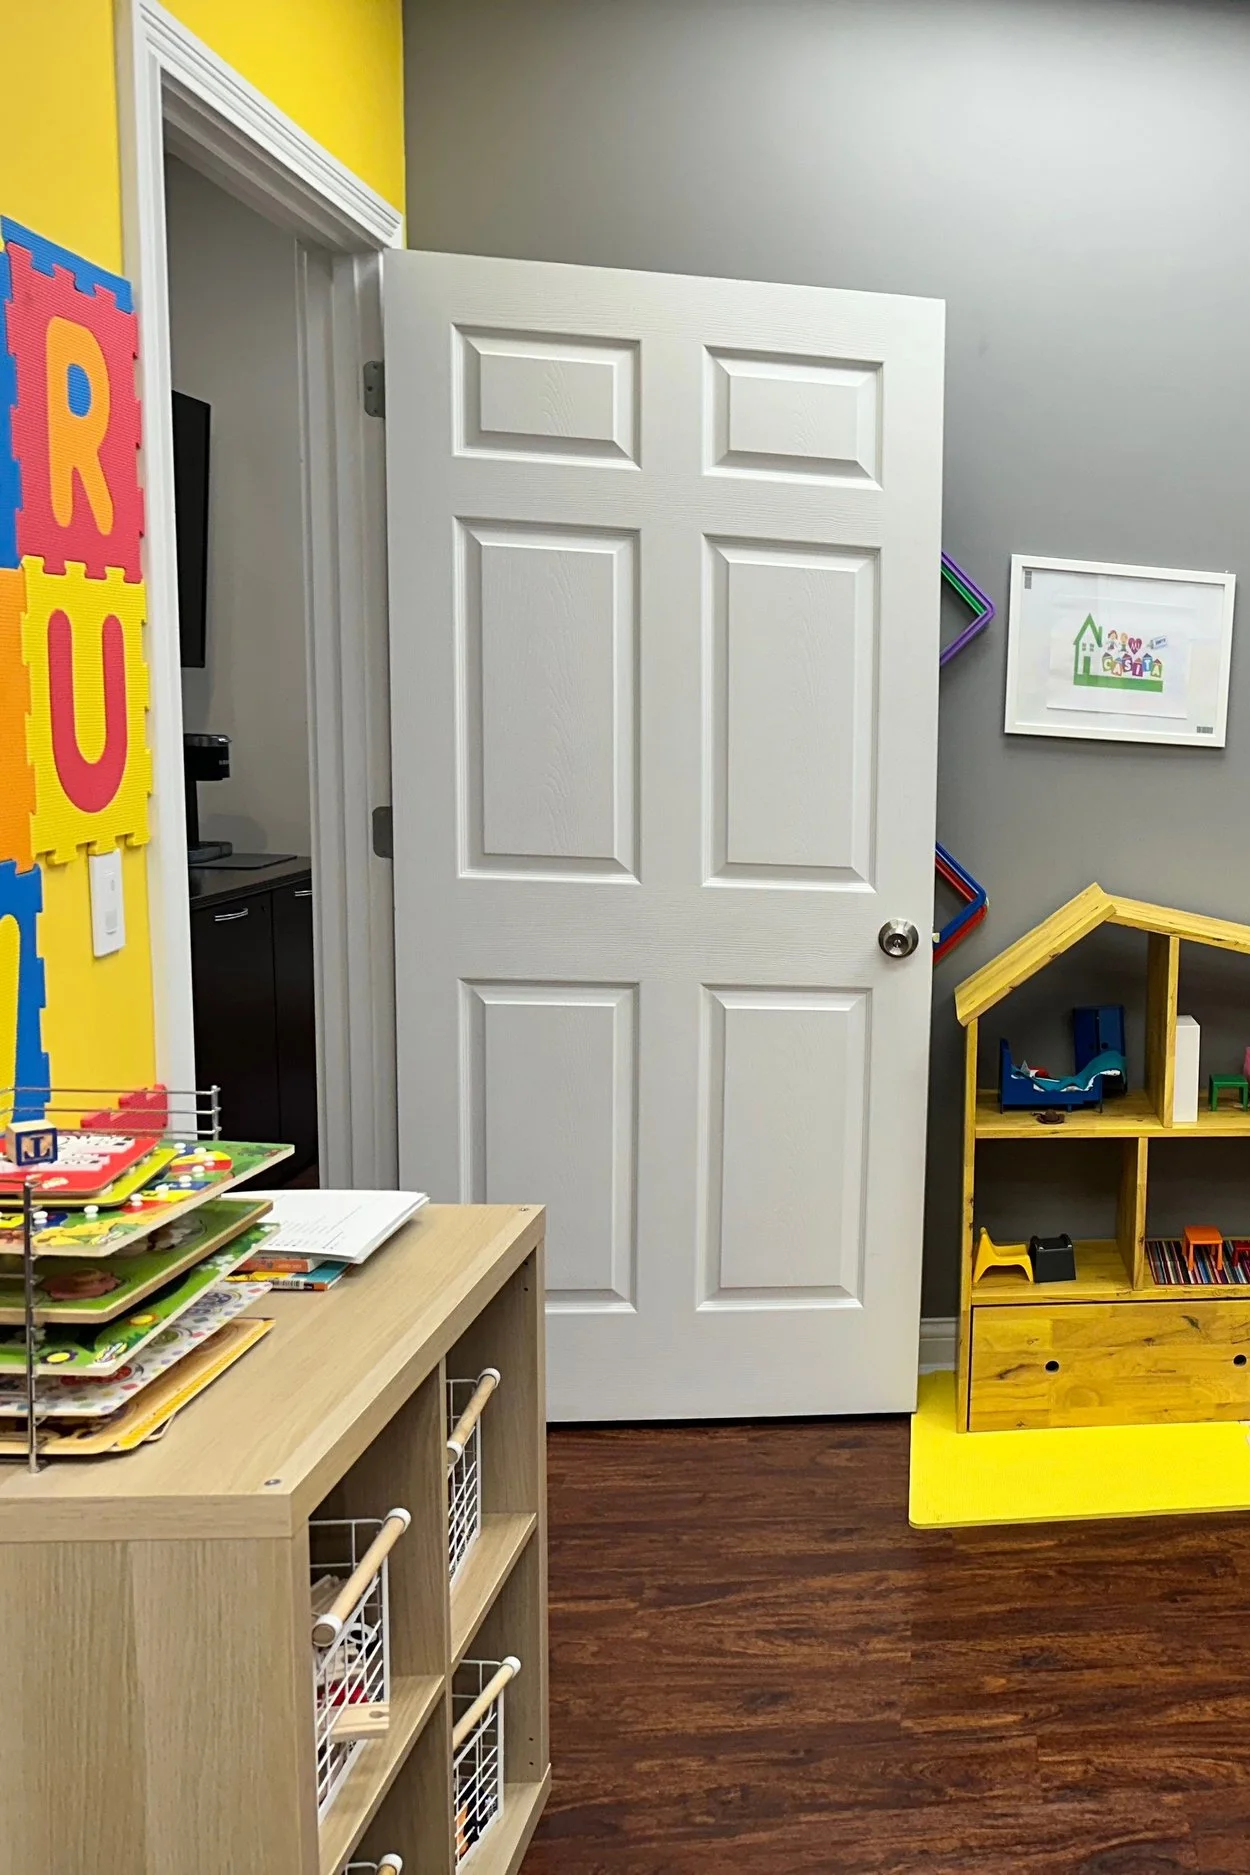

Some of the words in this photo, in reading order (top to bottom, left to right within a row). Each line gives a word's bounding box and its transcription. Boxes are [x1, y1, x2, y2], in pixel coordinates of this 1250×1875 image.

[46, 315, 114, 536] R
[47, 609, 128, 813] U
[1104, 658, 1161, 677] CASITA
